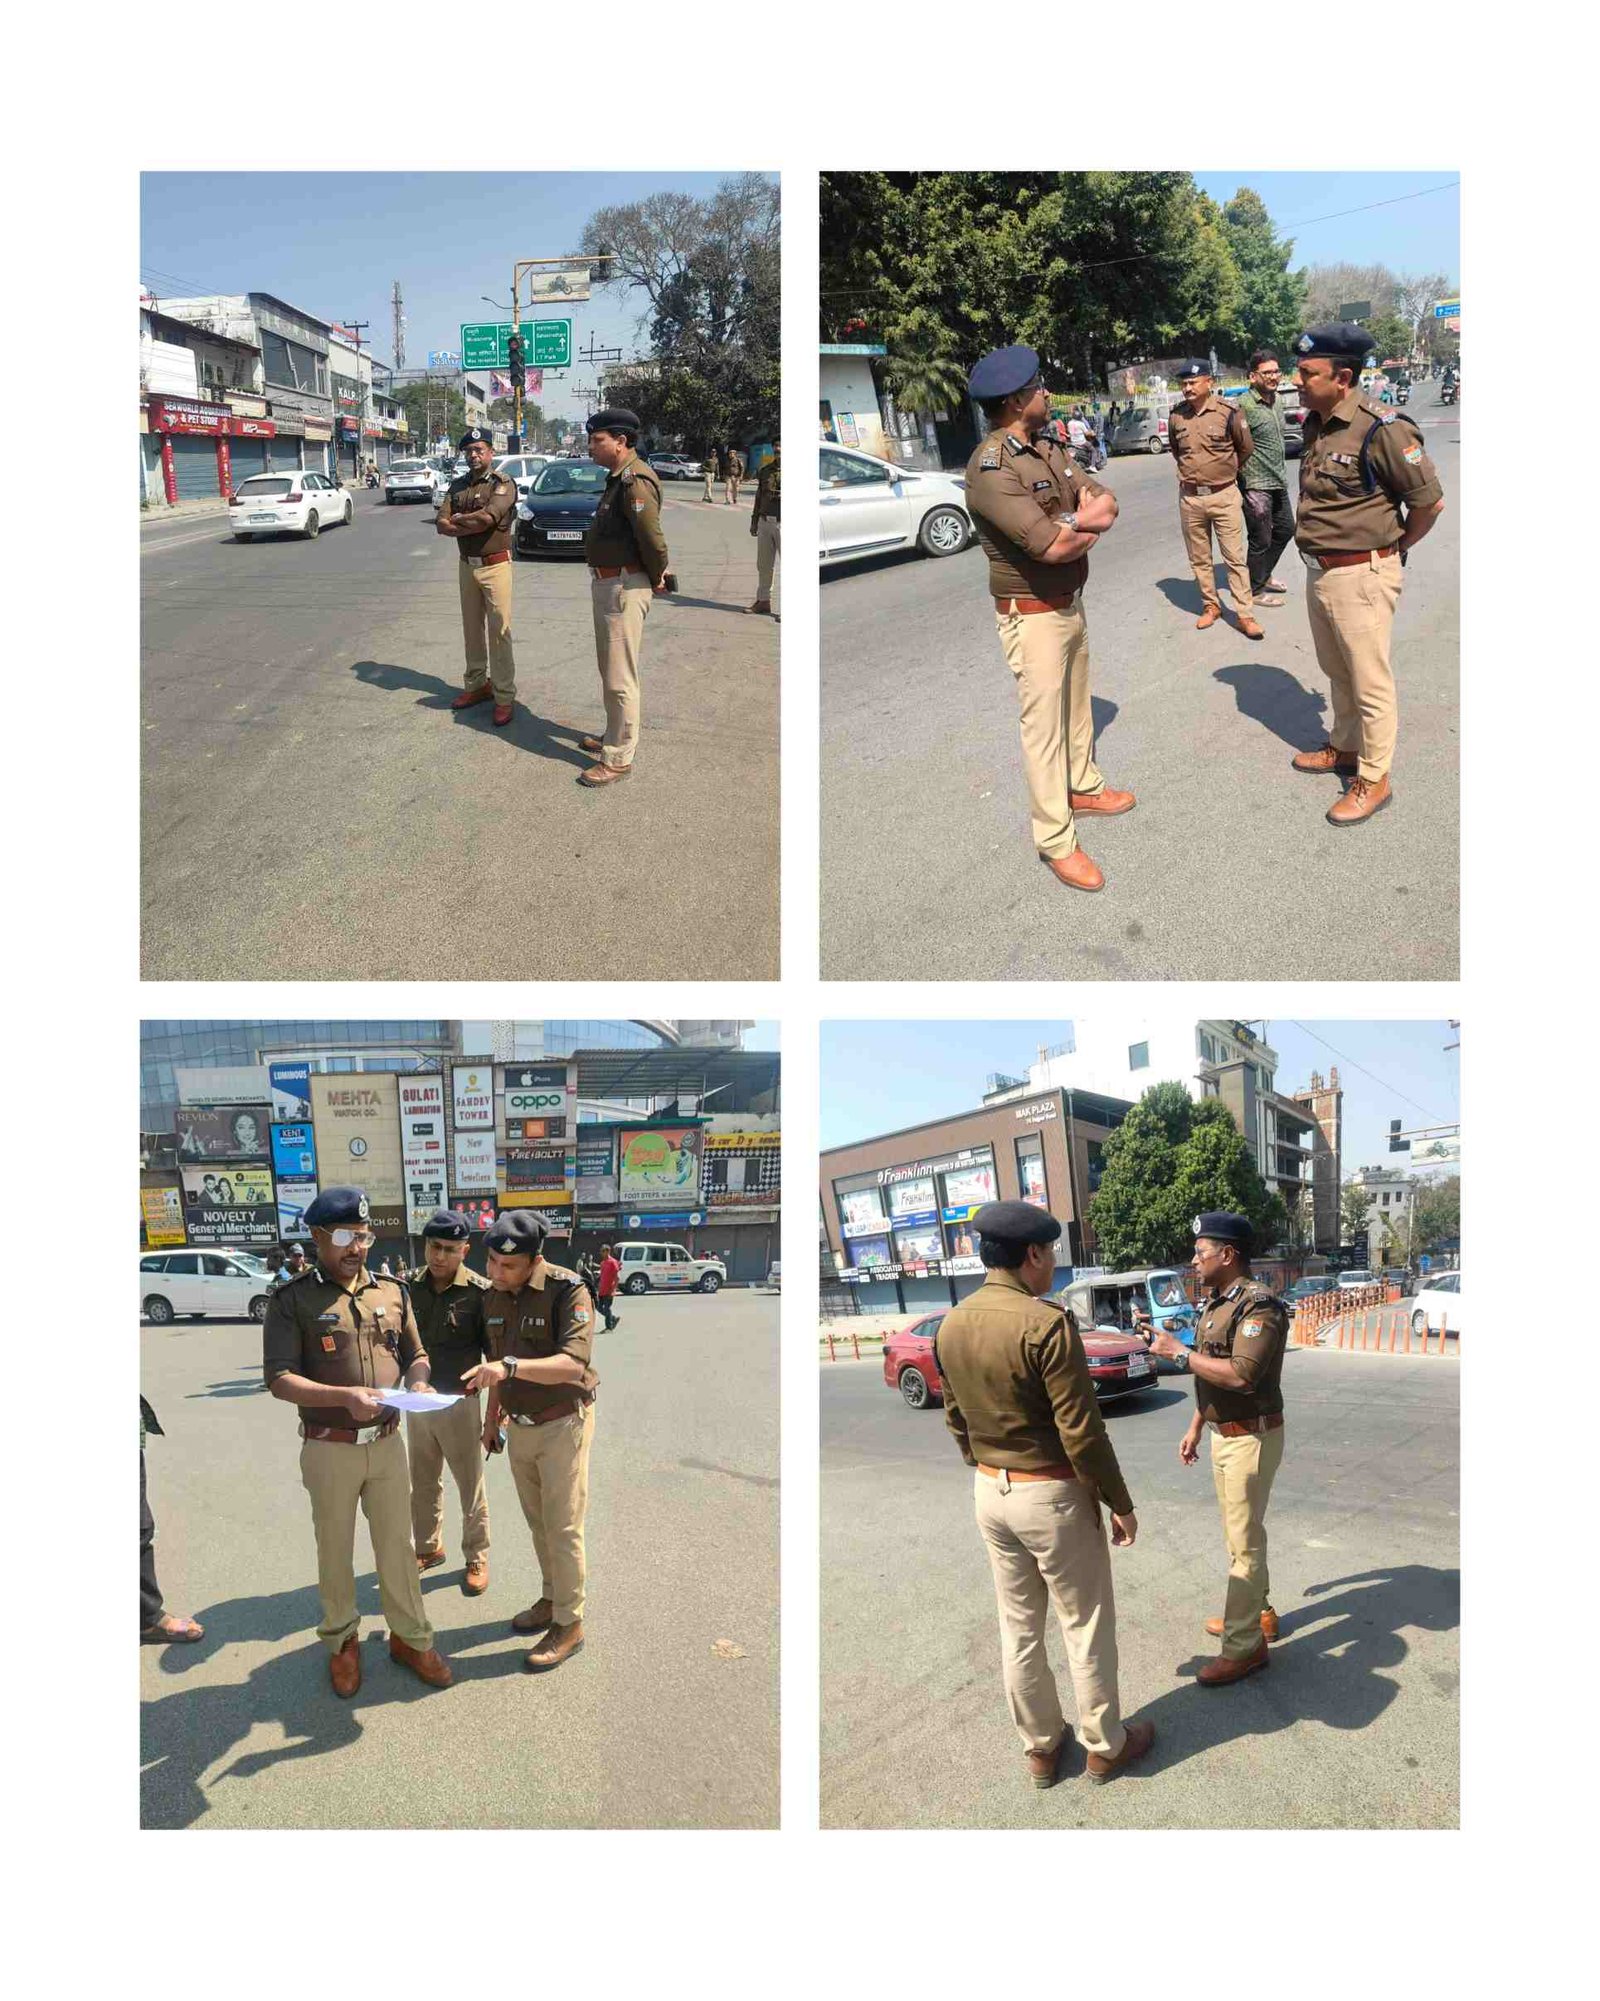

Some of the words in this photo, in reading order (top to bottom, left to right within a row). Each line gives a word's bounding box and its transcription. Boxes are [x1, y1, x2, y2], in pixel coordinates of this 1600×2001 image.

[187, 414, 199, 424] PET
[200, 416, 218, 425] STORE
[327, 1091, 381, 1106] MEHTA
[403, 1088, 439, 1102] GULATI
[456, 1096, 490, 1107] SAHDEV
[1032, 1101, 1056, 1115] PLAZA
[177, 1112, 218, 1122] REVLON
[334, 1109, 362, 1118] WATCH
[459, 1111, 488, 1121] TOWER
[459, 1155, 491, 1165] SAHDEV
[203, 1211, 256, 1222] NOVELTY
[386, 1217, 400, 1226] CO
[188, 1223, 225, 1234] General
[226, 1222, 276, 1233] Merchants
[870, 1264, 903, 1274] ASSOCIATED
[875, 1272, 899, 1281] TRADERS
